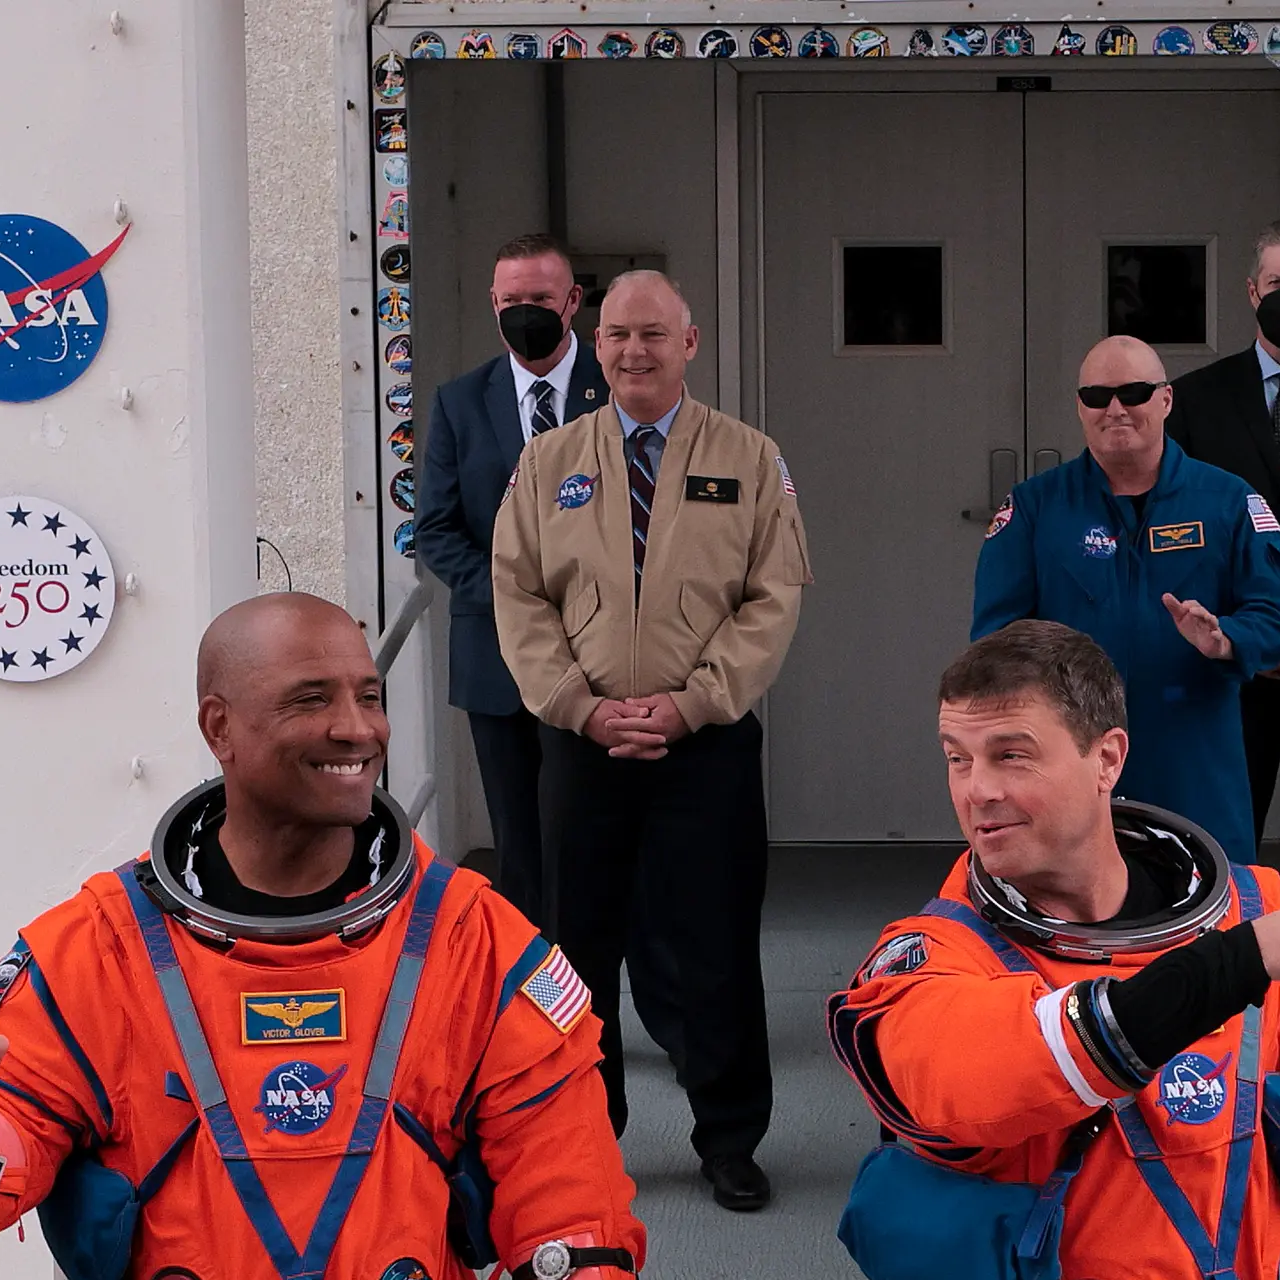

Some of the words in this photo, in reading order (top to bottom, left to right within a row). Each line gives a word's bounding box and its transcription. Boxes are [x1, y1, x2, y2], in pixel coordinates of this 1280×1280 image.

[560, 484, 593, 498] NASA
[1083, 533, 1117, 551] NASA
[262, 1029, 290, 1038] VICTOR
[294, 1027, 325, 1037] GLOVER
[1164, 1078, 1224, 1099] NASA
[265, 1090, 332, 1106] NASA
